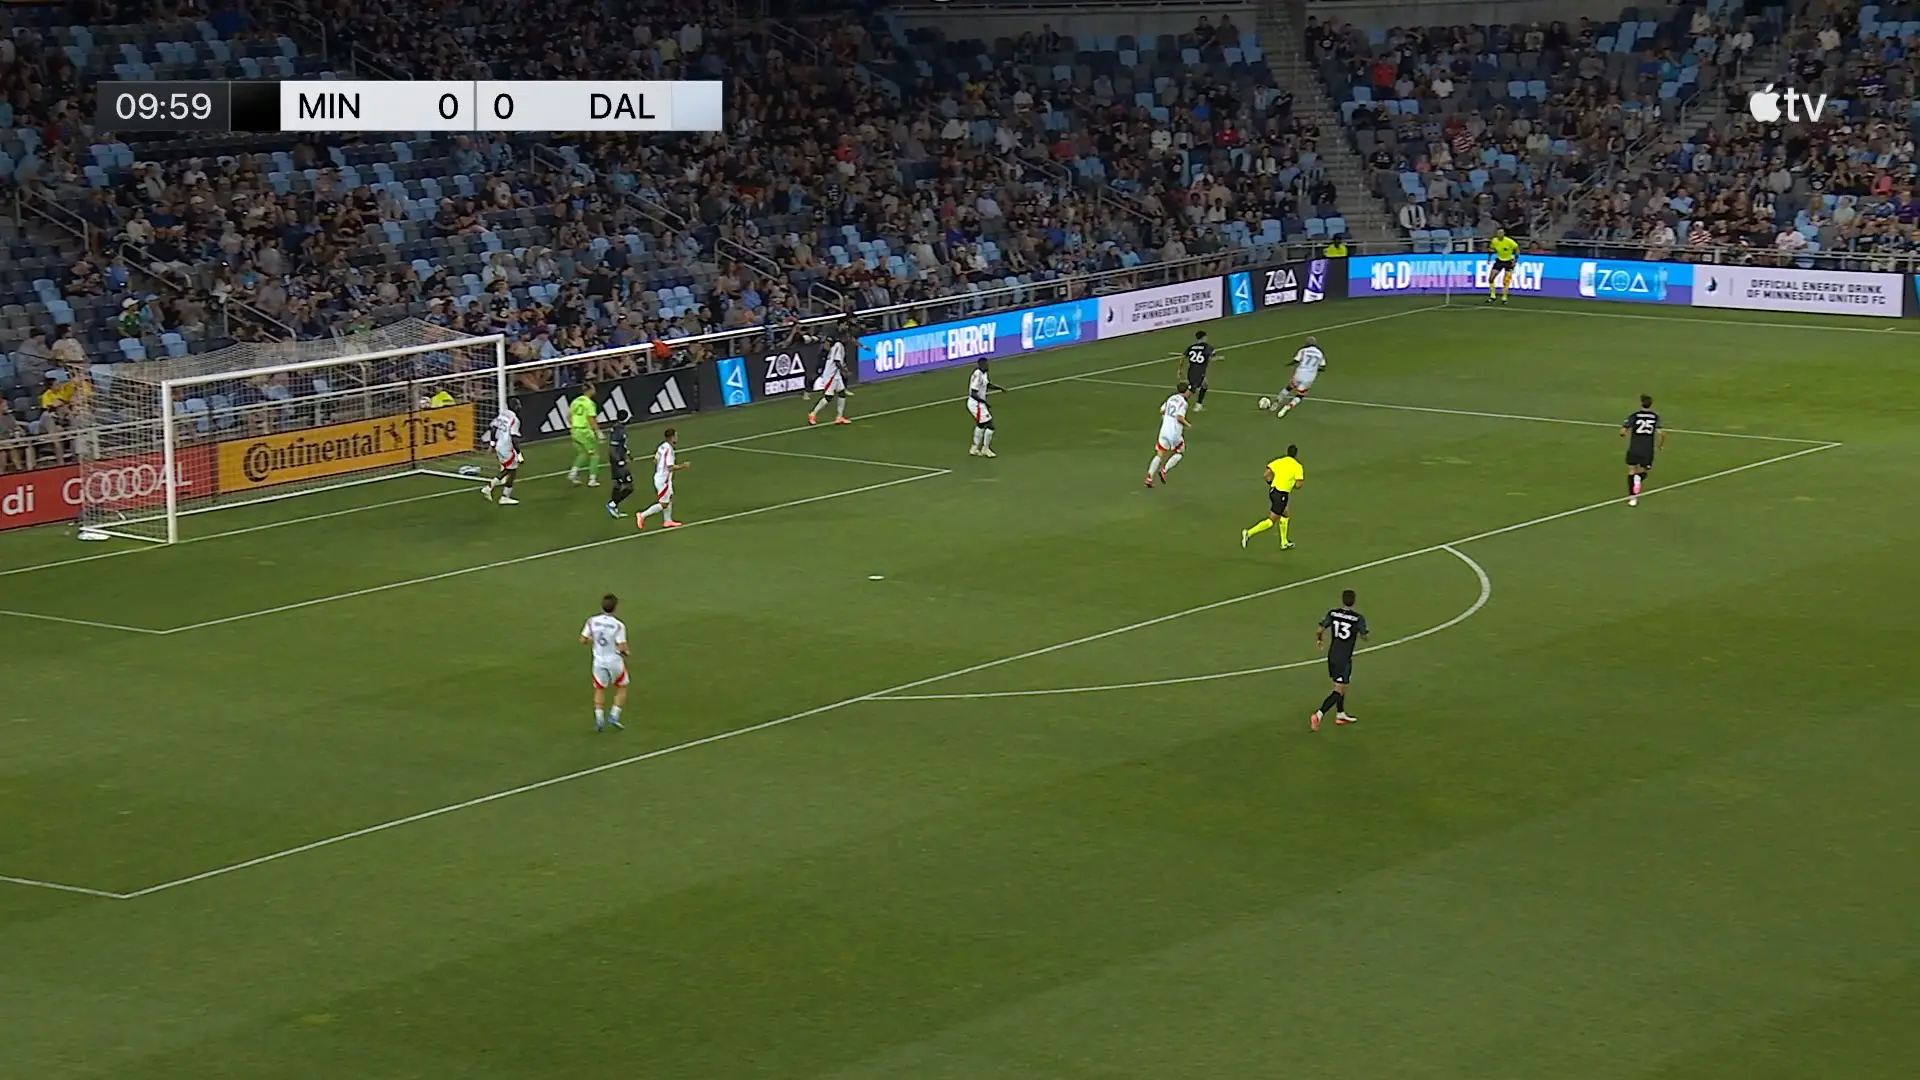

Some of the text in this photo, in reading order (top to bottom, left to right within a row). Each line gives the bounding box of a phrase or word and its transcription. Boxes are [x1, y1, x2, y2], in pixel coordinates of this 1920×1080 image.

[1264, 269, 1298, 291] ZOA
[1396, 260, 1473, 289] DWAYNE
[1597, 269, 1649, 293] ZOA
[1746, 289, 1886, 305] OF MINNESOTA UNITED FC
[1750, 279, 1882, 294] OFFICIAL ENERGY DRINK
[1134, 290, 1212, 312] OFFICIAL ENERGY DRINK
[1142, 306, 1180, 320] MINNESOTA
[1204, 299, 1215, 309] FC
[1033, 314, 1071, 341] ZOA
[947, 322, 997, 360] ENERGY
[765, 353, 806, 379] ZOA
[1188, 350, 1206, 364] 26
[1635, 419, 1657, 435] 25
[243, 416, 457, 482] Continental Tire
[2, 484, 35, 516] di
[597, 631, 609, 647] 6
[1332, 619, 1352, 640] 13
